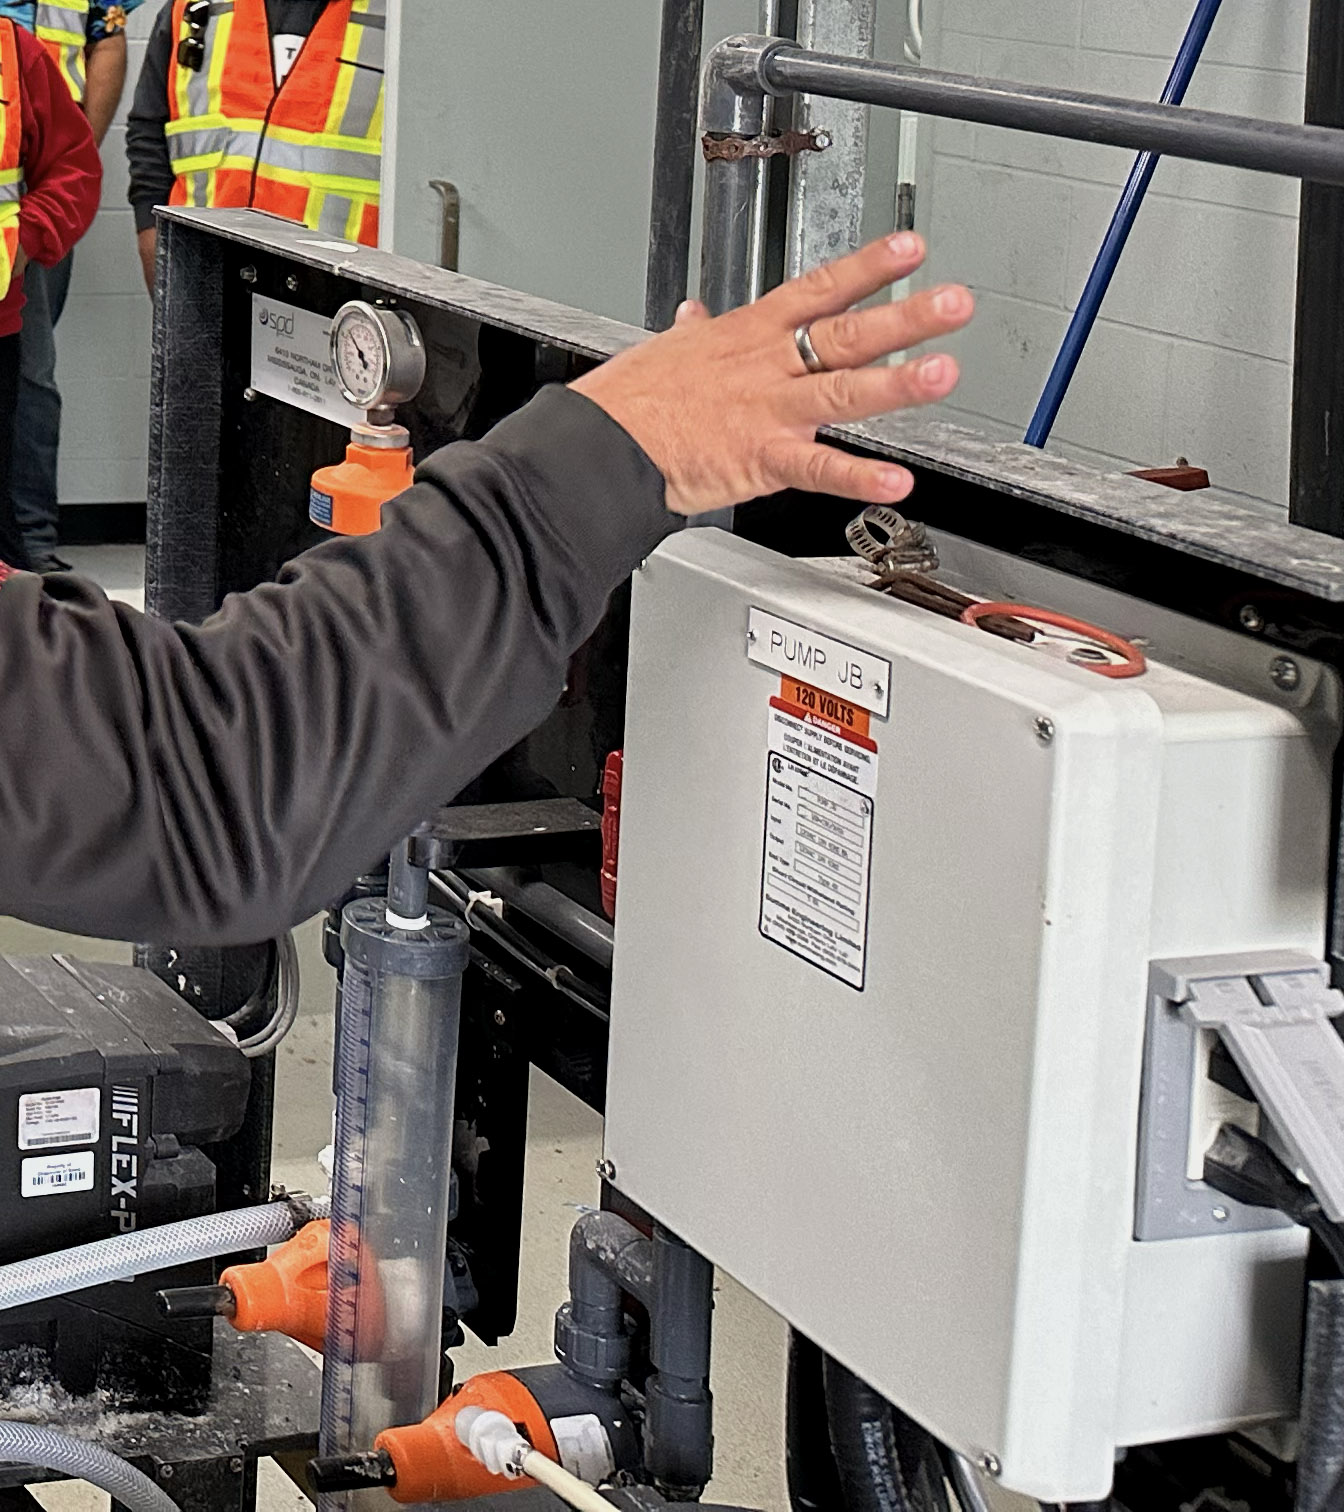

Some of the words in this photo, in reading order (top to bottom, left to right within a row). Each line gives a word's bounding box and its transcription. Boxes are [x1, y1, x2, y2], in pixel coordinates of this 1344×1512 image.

[269, 312, 295, 338] spd
[770, 629, 827, 672] PUMP
[837, 660, 864, 690] JB
[795, 686, 816, 709] 120
[819, 694, 855, 727] VOLTS
[812, 717, 841, 736] DANGER
[791, 907, 834, 938] Engineering
[834, 931, 862, 952] Limited
